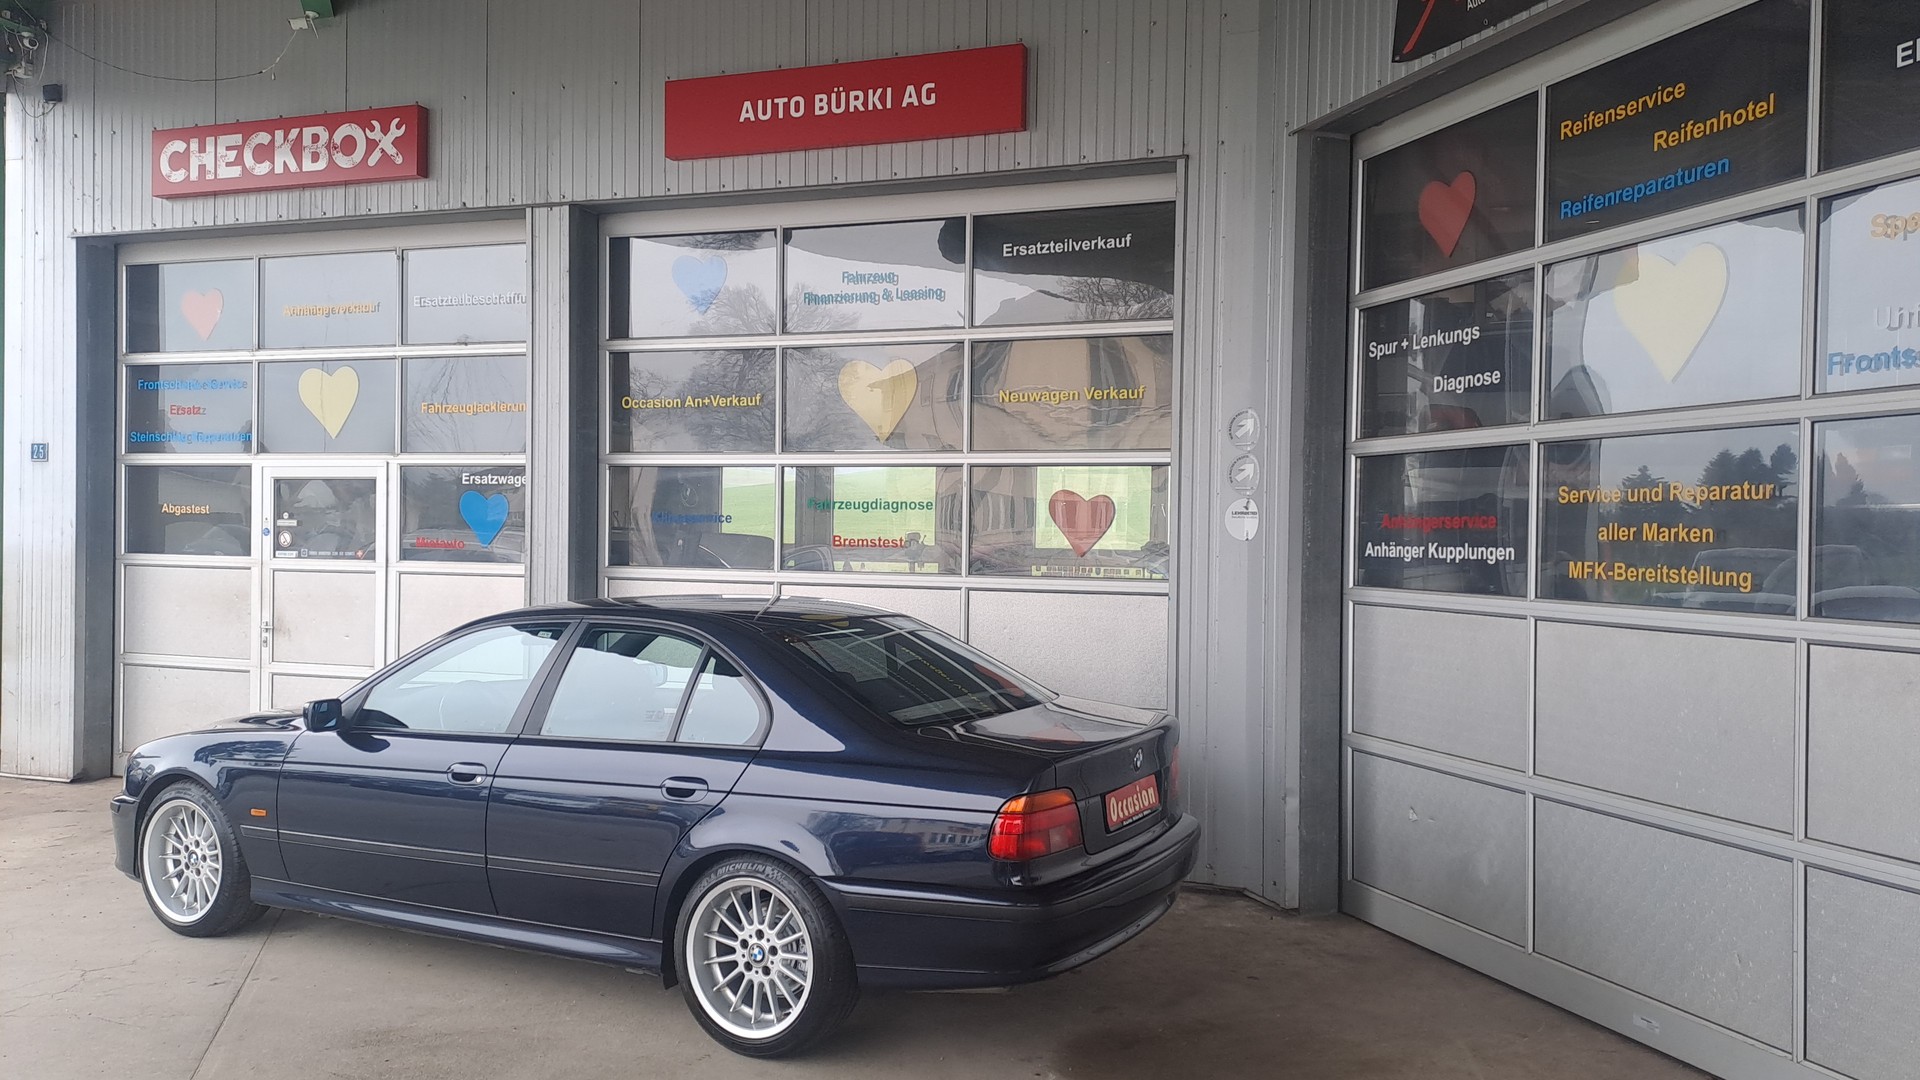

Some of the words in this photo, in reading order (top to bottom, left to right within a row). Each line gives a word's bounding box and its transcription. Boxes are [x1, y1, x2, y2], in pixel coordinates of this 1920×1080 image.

[739, 95, 805, 123] AUTO
[814, 87, 892, 116] BÜRKI
[902, 82, 936, 107] AG
[1560, 82, 1686, 140] Reifenservice
[1653, 92, 1776, 151] Reifenhotel
[159, 117, 406, 184] CHECKBOX
[1560, 157, 1730, 219] Reifenreparaturen
[1002, 233, 1132, 258] Ersatzteilverkauf
[842, 271, 899, 285] Fahrzeug
[882, 288, 894, 302] &
[896, 286, 945, 302] Leasing
[1368, 341, 1399, 360] Spur
[1401, 338, 1409, 349] +
[1412, 326, 1480, 350] Lenkungs
[1433, 370, 1501, 393] Diagnose
[621, 395, 681, 409] Occasion
[685, 393, 761, 408] An+Verkauf
[999, 387, 1079, 404] Neuwagen
[1083, 385, 1146, 401] Verkauf
[170, 404, 204, 416] Ersatz
[33, 444, 44, 459] 25
[1558, 485, 1622, 504] Service
[1628, 484, 1663, 502] und
[1670, 481, 1775, 505] Reparatur
[161, 503, 210, 516] Abgastest
[807, 497, 933, 513] Fahrzeugdiagnose
[1381, 513, 1498, 533] Anhängerservice
[1597, 522, 1637, 541] aller
[1642, 522, 1714, 543] Marken
[832, 534, 905, 549] Bremstest
[1364, 541, 1425, 562] Anhänger
[1428, 542, 1515, 565] Kupplungen
[1568, 561, 1752, 592] MFK-Bereitstellung
[1110, 785, 1156, 822] Occasion
[717, 863, 765, 877] MICHELIN
